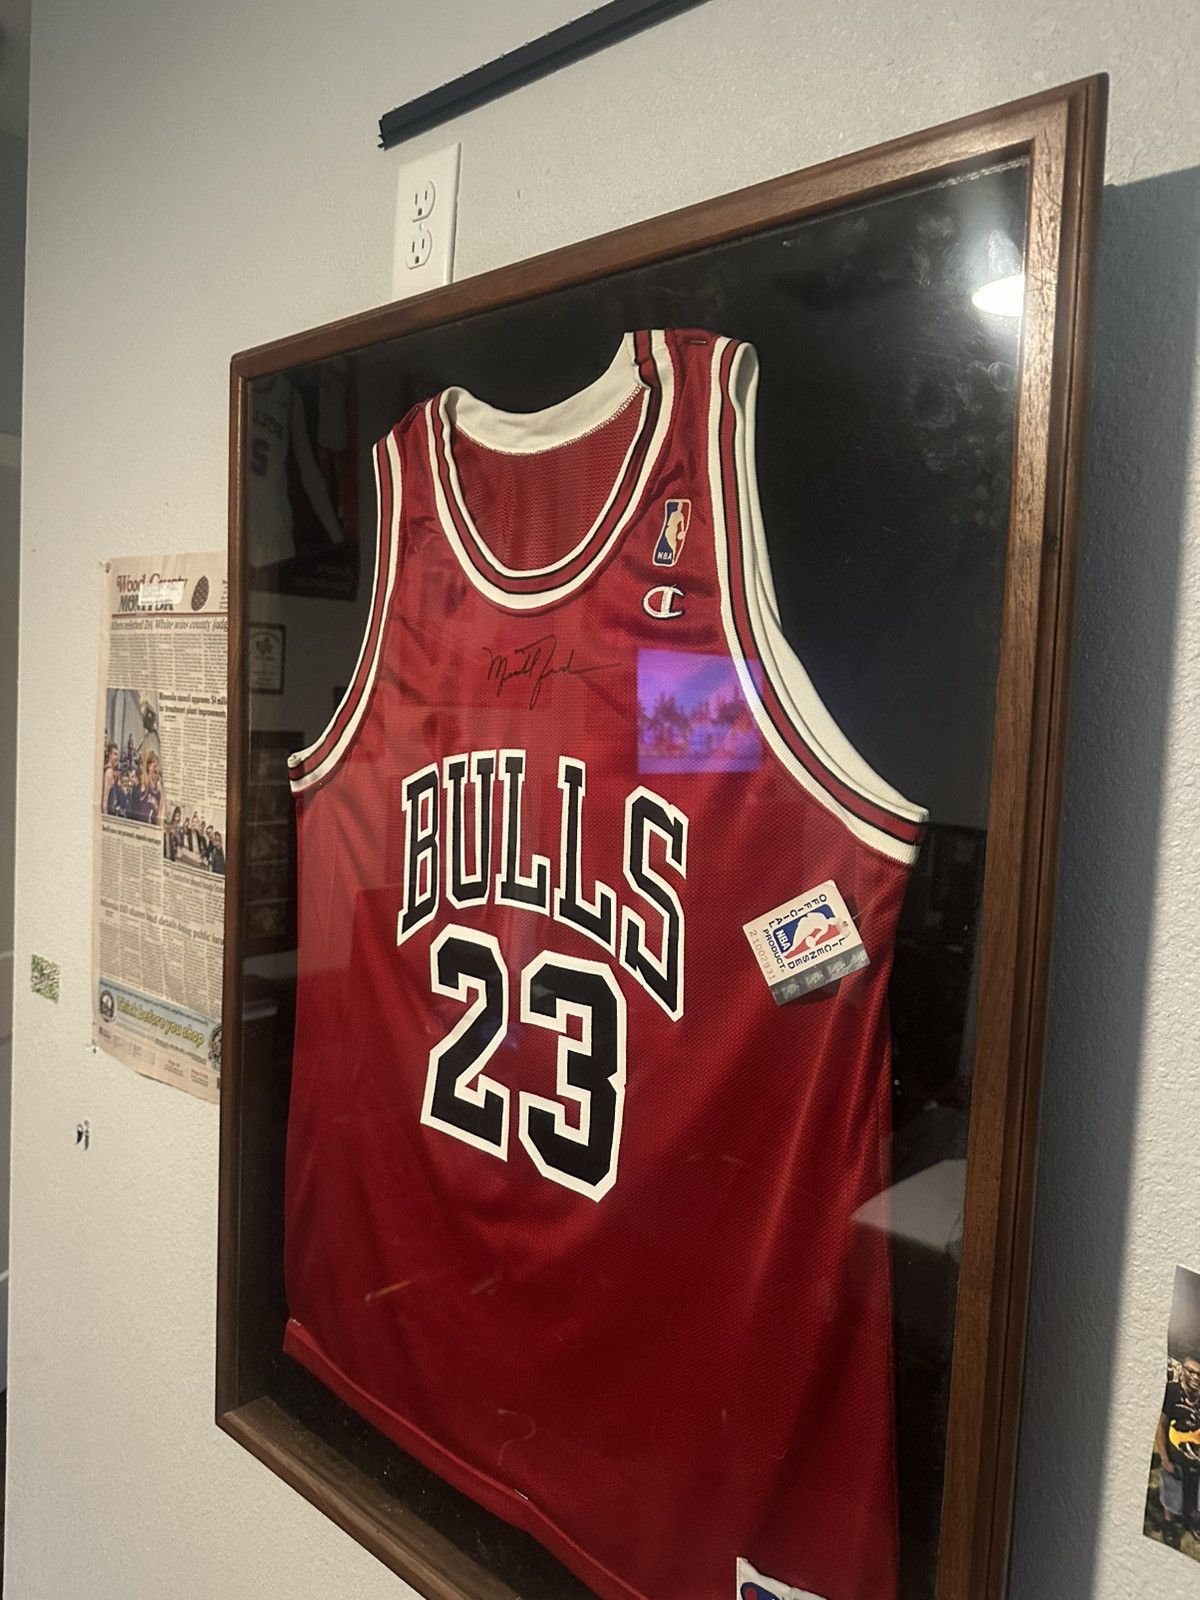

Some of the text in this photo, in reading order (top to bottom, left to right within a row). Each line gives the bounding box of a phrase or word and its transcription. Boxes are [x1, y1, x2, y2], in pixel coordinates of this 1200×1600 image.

[657, 551, 673, 561] NBA
[397, 748, 690, 1022] BULLS
[768, 894, 828, 928] OFFICIAL
[763, 928, 786, 970] PRODUCT
[775, 929, 792, 951] NBA
[787, 937, 846, 970] LICENSED
[419, 923, 627, 1203] 23
